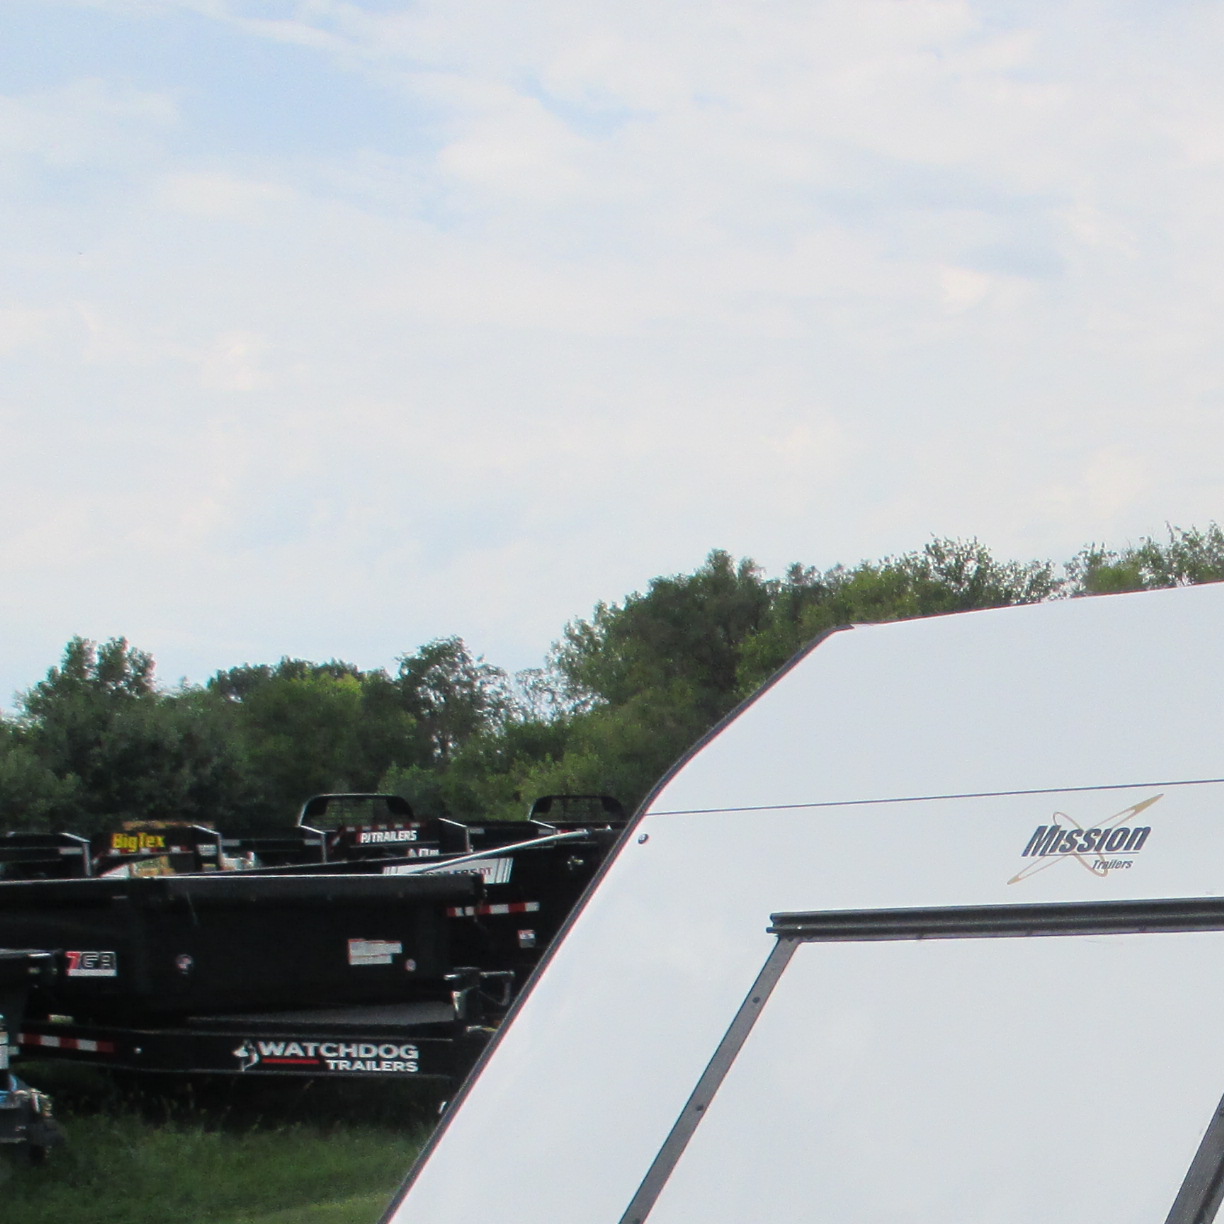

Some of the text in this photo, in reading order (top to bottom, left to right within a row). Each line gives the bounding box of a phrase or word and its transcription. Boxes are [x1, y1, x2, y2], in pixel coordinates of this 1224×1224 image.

[371, 830, 417, 842] TRAILERS
[1021, 825, 1152, 857] Mission
[1092, 859, 1133, 870] Trailers
[258, 1041, 419, 1059] WATCHDOG
[325, 1060, 419, 1072] TRAILERS
